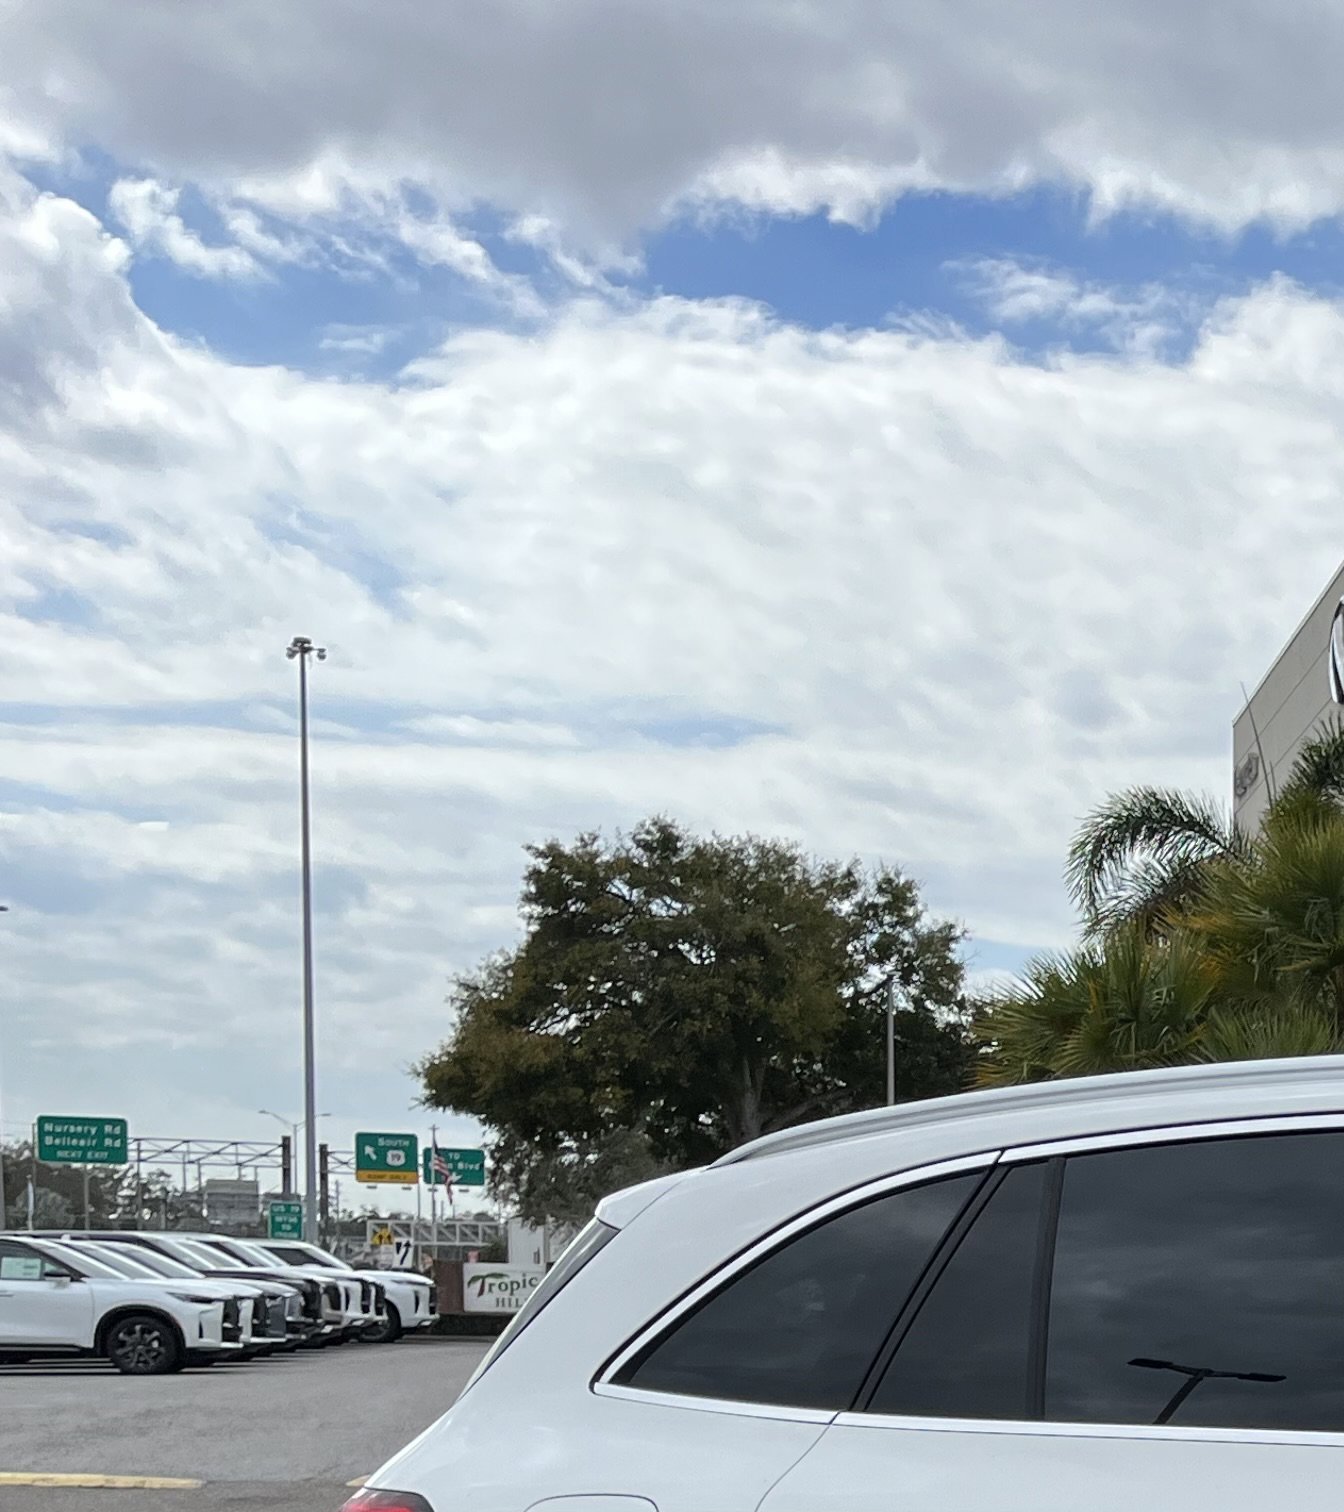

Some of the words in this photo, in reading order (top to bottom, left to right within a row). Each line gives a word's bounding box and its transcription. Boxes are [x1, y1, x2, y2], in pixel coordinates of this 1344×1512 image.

[43, 1122, 98, 1136] Nursery
[103, 1124, 121, 1135] Rd
[44, 1135, 97, 1146] Belleair
[103, 1137, 121, 1147] Rd
[457, 1161, 480, 1170] Blvd
[467, 1272, 539, 1298] Tropic
[495, 1297, 527, 1308] HIL
